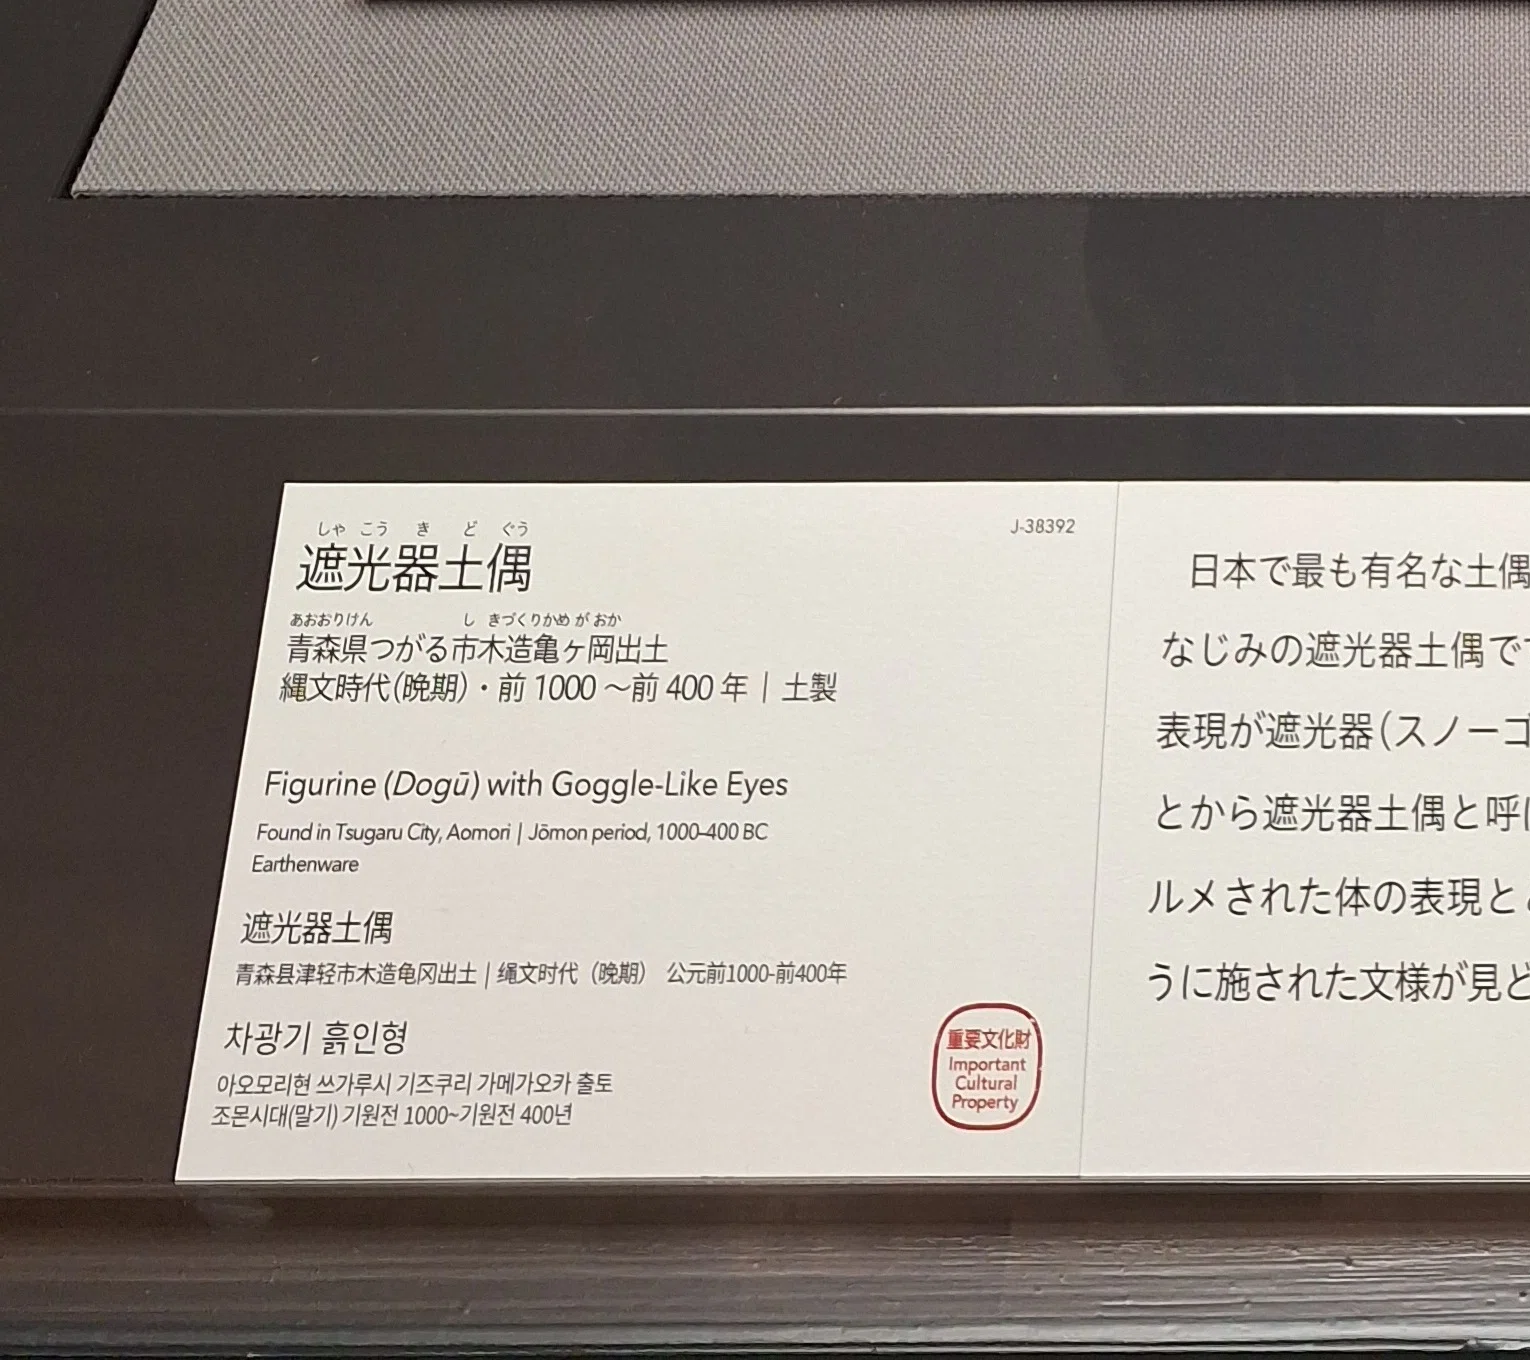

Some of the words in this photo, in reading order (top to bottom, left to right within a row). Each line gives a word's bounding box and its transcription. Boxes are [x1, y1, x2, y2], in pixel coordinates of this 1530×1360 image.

[318, 521, 346, 537] しゃ
[360, 520, 388, 537] こう
[416, 520, 430, 538] き
[463, 520, 478, 537] ど
[502, 520, 529, 537] ぐう
[1010, 518, 1076, 535] J-38392
[295, 542, 532, 594] 遮光器土偶
[464, 612, 476, 628] し
[488, 611, 571, 628] きづくりかめ
[574, 611, 591, 628] が
[593, 611, 622, 628] おか
[535, 671, 597, 703] 1000
[781, 671, 838, 703] 土製
[264, 770, 377, 805] Figurine
[384, 769, 480, 805] (Dogū)
[487, 768, 543, 797] with
[551, 768, 718, 805] Goggle-Like
[726, 770, 789, 805] Eyes
[256, 821, 314, 841] Found
[316, 822, 331, 841] in
[335, 822, 404, 846] Tsugaru
[407, 822, 443, 847] City,
[445, 822, 512, 841] Aomori
[527, 822, 588, 841] Jōmon
[591, 821, 652, 846] period,
[742, 822, 769, 841] BC
[251, 853, 360, 873] Earthenware
[223, 1020, 312, 1056] 차광기
[321, 1019, 408, 1056] 흙인형
[945, 1027, 1033, 1051] 重要文化財
[948, 1055, 1027, 1077] Important
[217, 1072, 312, 1098] 아오모리현
[315, 1072, 392, 1097] 쓰가루시
[396, 1071, 473, 1097] 기즈쿠리
[476, 1071, 572, 1096] 가메가오카
[576, 1071, 613, 1096] 출토
[955, 1073, 1018, 1091] Cultural
[951, 1093, 1019, 1114] Property
[210, 1103, 338, 1131] 조몬시대(말기)
[341, 1103, 399, 1128] 기원전
[519, 1102, 573, 1126] 400년
